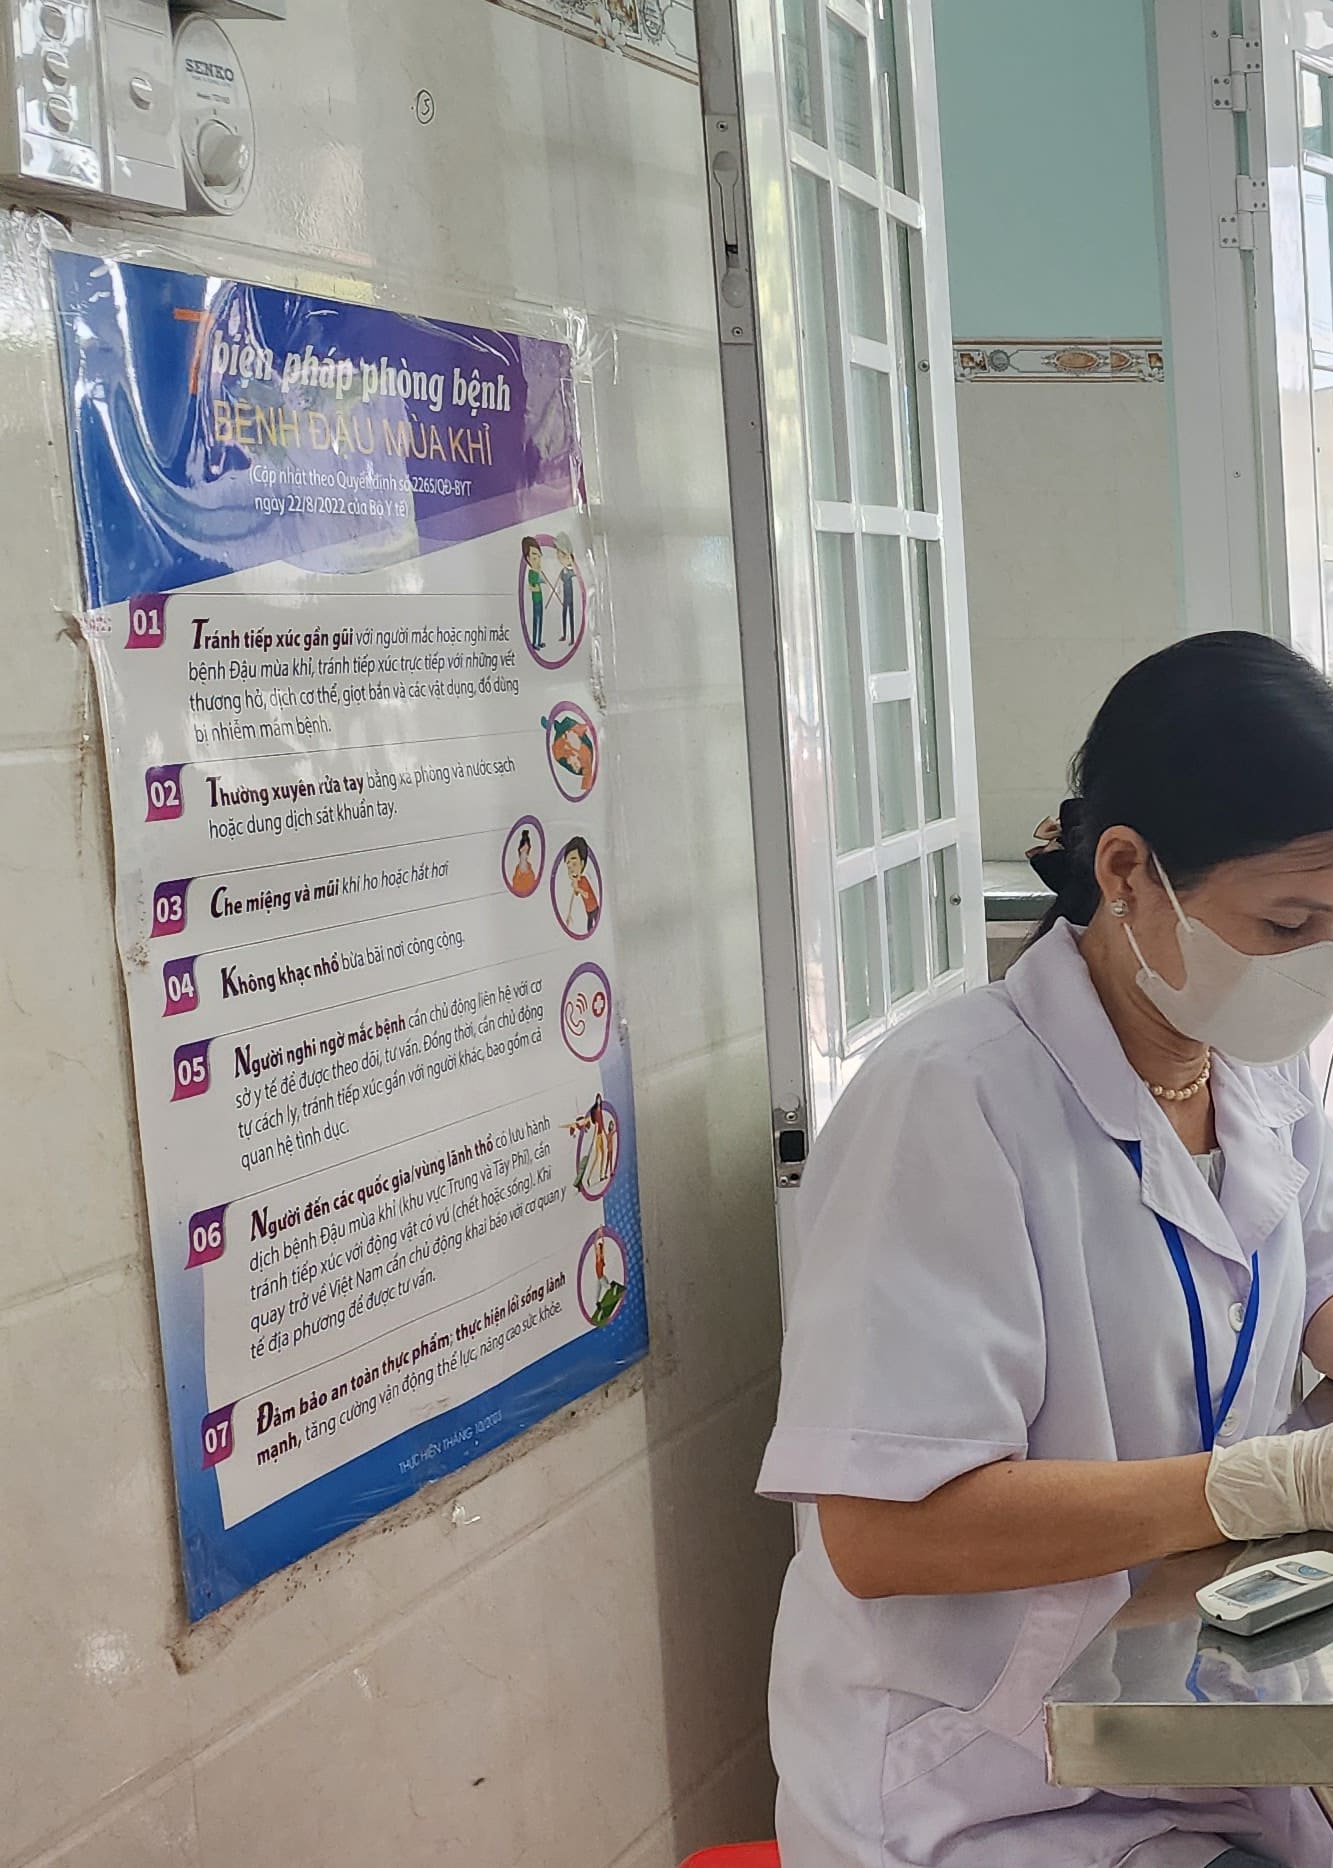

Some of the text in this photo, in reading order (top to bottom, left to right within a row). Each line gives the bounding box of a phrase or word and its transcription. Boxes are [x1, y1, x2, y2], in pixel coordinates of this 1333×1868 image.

[185, 58, 234, 82] SENKO
[213, 331, 512, 417] biện pháp phòng bệnh
[213, 398, 494, 466] BỆNH ĐẬU MÙA KHỈ
[309, 469, 335, 487] theo
[255, 496, 284, 516] ngày
[287, 495, 345, 515] 22/8/2022
[384, 500, 393, 516] Y
[133, 609, 161, 636] 01
[192, 618, 510, 652] Tránh tiếp xúc gần gũi với người mắc hoặc nghi mắc
[189, 660, 226, 685] bệnh
[229, 660, 256, 682] Đậu
[260, 659, 288, 678] mùa
[292, 657, 315, 678] khỉ,
[318, 656, 350, 675] tránh
[353, 654, 375, 677] tiếp
[378, 654, 398, 672] xúc
[400, 656, 422, 674] trực
[424, 651, 445, 674] tiếp
[447, 652, 464, 669] với
[466, 652, 498, 672] những
[190, 692, 242, 714] thương
[244, 688, 266, 710] hở,
[270, 687, 297, 711] dịch
[300, 690, 314, 704] cơ
[316, 682, 340, 705] thể,
[342, 684, 366, 706] giọt
[392, 682, 406, 698] và
[408, 680, 426, 698] các
[493, 676, 519, 696] dùng
[212, 719, 256, 741] nhiễm
[296, 715, 332, 738] bệnh.
[151, 780, 180, 808] 02
[206, 776, 269, 808] Thường
[271, 779, 316, 802] xuyên
[319, 774, 341, 794] rửa
[343, 776, 364, 794] tay
[366, 768, 397, 790] bằng
[451, 762, 464, 778] và
[492, 756, 516, 776] sạch
[209, 798, 397, 840] hoặc dung dịch sát khuẩn tay.
[210, 886, 242, 918] Che
[246, 890, 291, 912] miệng
[294, 884, 310, 903] và
[314, 878, 339, 900] mũi
[363, 874, 378, 890] ho
[381, 868, 409, 888] hoặc
[431, 860, 448, 878] hơi
[156, 895, 182, 923] 03
[220, 965, 279, 999] Không
[278, 965, 312, 985] khạc
[313, 952, 339, 977] nhổ
[366, 945, 384, 964] bãi
[386, 940, 404, 960] nơi
[407, 937, 434, 955] công
[168, 973, 194, 1002] 04
[234, 1044, 284, 1078] Người
[286, 1038, 316, 1065] nghi
[320, 1031, 345, 1056] ngờ
[348, 1022, 374, 1046] mắc
[375, 1014, 406, 1040] bệnh
[430, 1002, 448, 1022] chủ
[450, 998, 476, 1018] động
[512, 980, 528, 998] với
[177, 1057, 206, 1086] 05
[242, 1120, 349, 1171] quan hệ tình dục.
[250, 1206, 301, 1242] Người
[304, 1196, 330, 1221] đến
[333, 1190, 355, 1210] các
[357, 1174, 389, 1204] quốc
[446, 1144, 473, 1168] lãnh
[474, 1133, 494, 1156] thổ
[525, 1115, 550, 1138] hành
[193, 1223, 221, 1253] 06
[256, 1401, 296, 1436] Đảm
[300, 1391, 328, 1415] bảo
[331, 1383, 348, 1401] an
[350, 1367, 379, 1391] toàn
[382, 1352, 410, 1375] thực
[204, 1421, 229, 1454] 07
